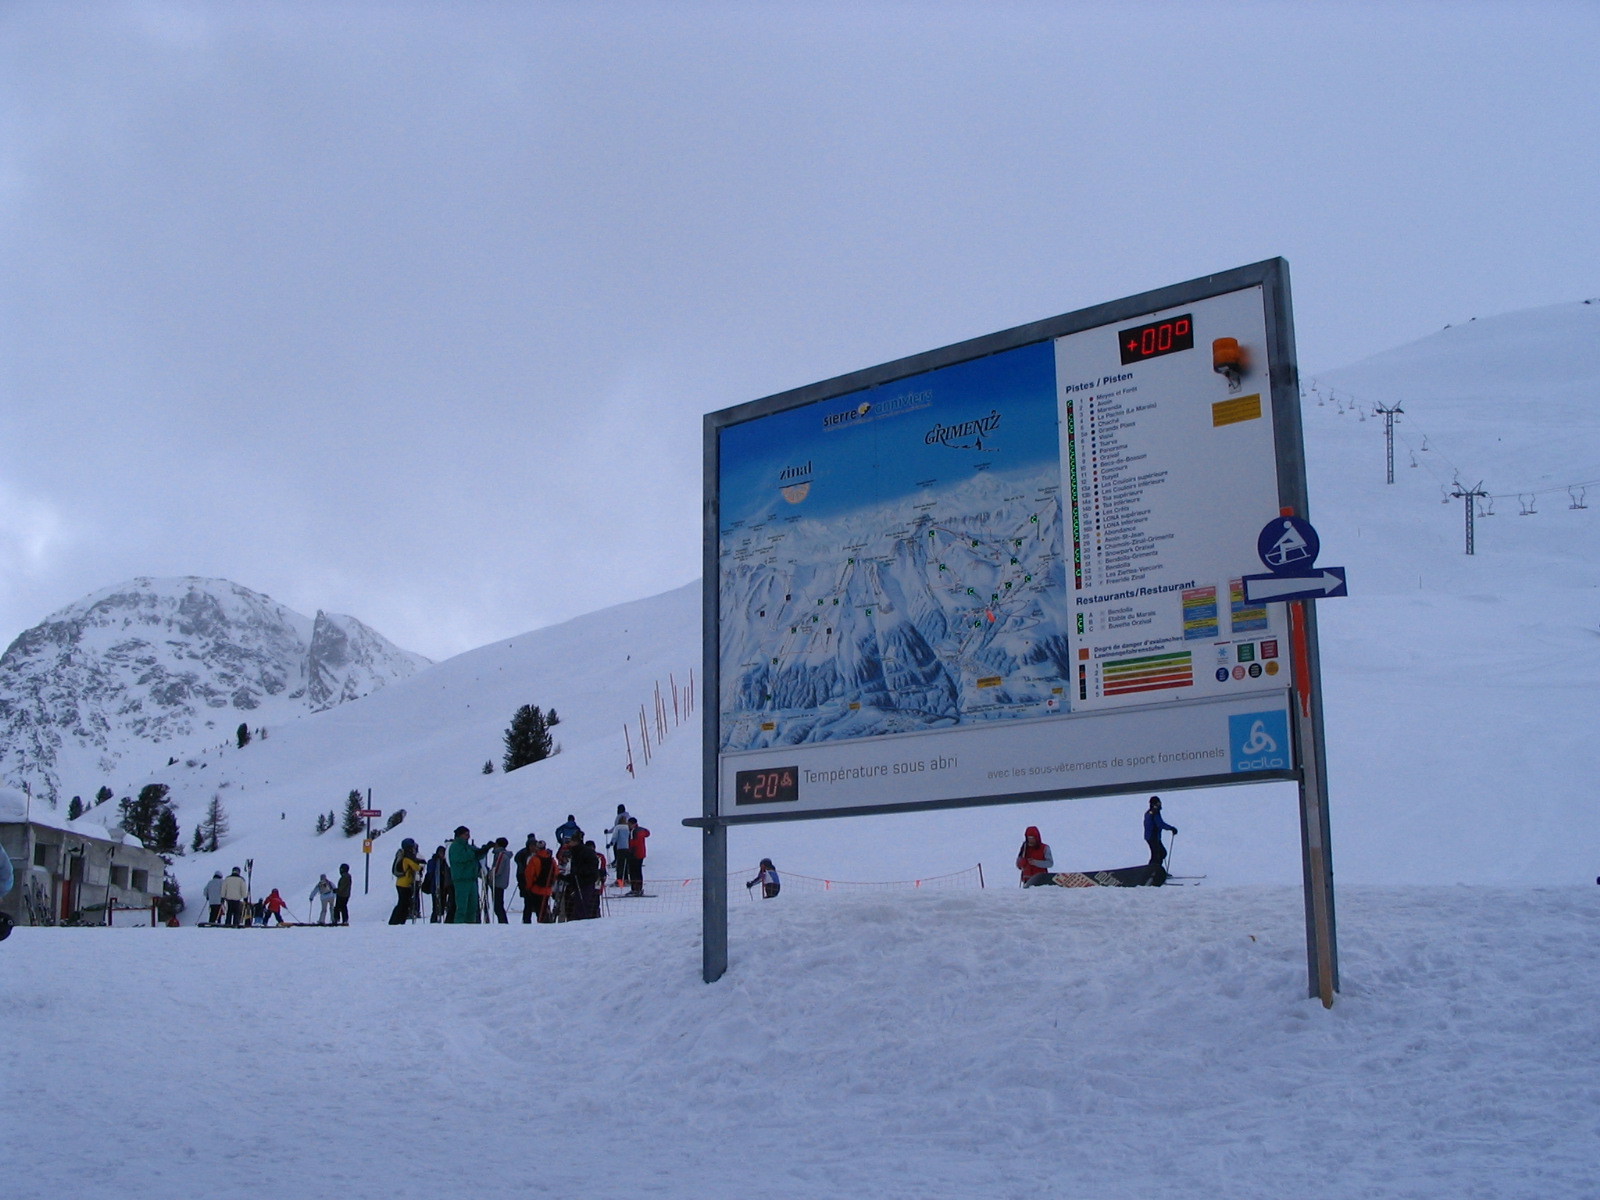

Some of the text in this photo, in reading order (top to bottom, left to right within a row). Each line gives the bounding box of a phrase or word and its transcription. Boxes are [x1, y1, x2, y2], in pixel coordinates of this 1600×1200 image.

[1066, 381, 1094, 394] Pistes
[1103, 372, 1133, 385] Pisten
[824, 389, 933, 427] sierre anniviers
[925, 410, 1001, 446] GRIMENTZ
[779, 460, 812, 480] zinal
[1076, 580, 1196, 606] Restaurants/Restaurant
[804, 755, 958, 785] Température sous abri
[987, 747, 1225, 780] avec les sous-vêtements de sport fonctionnels
[1238, 756, 1283, 770] odlo
